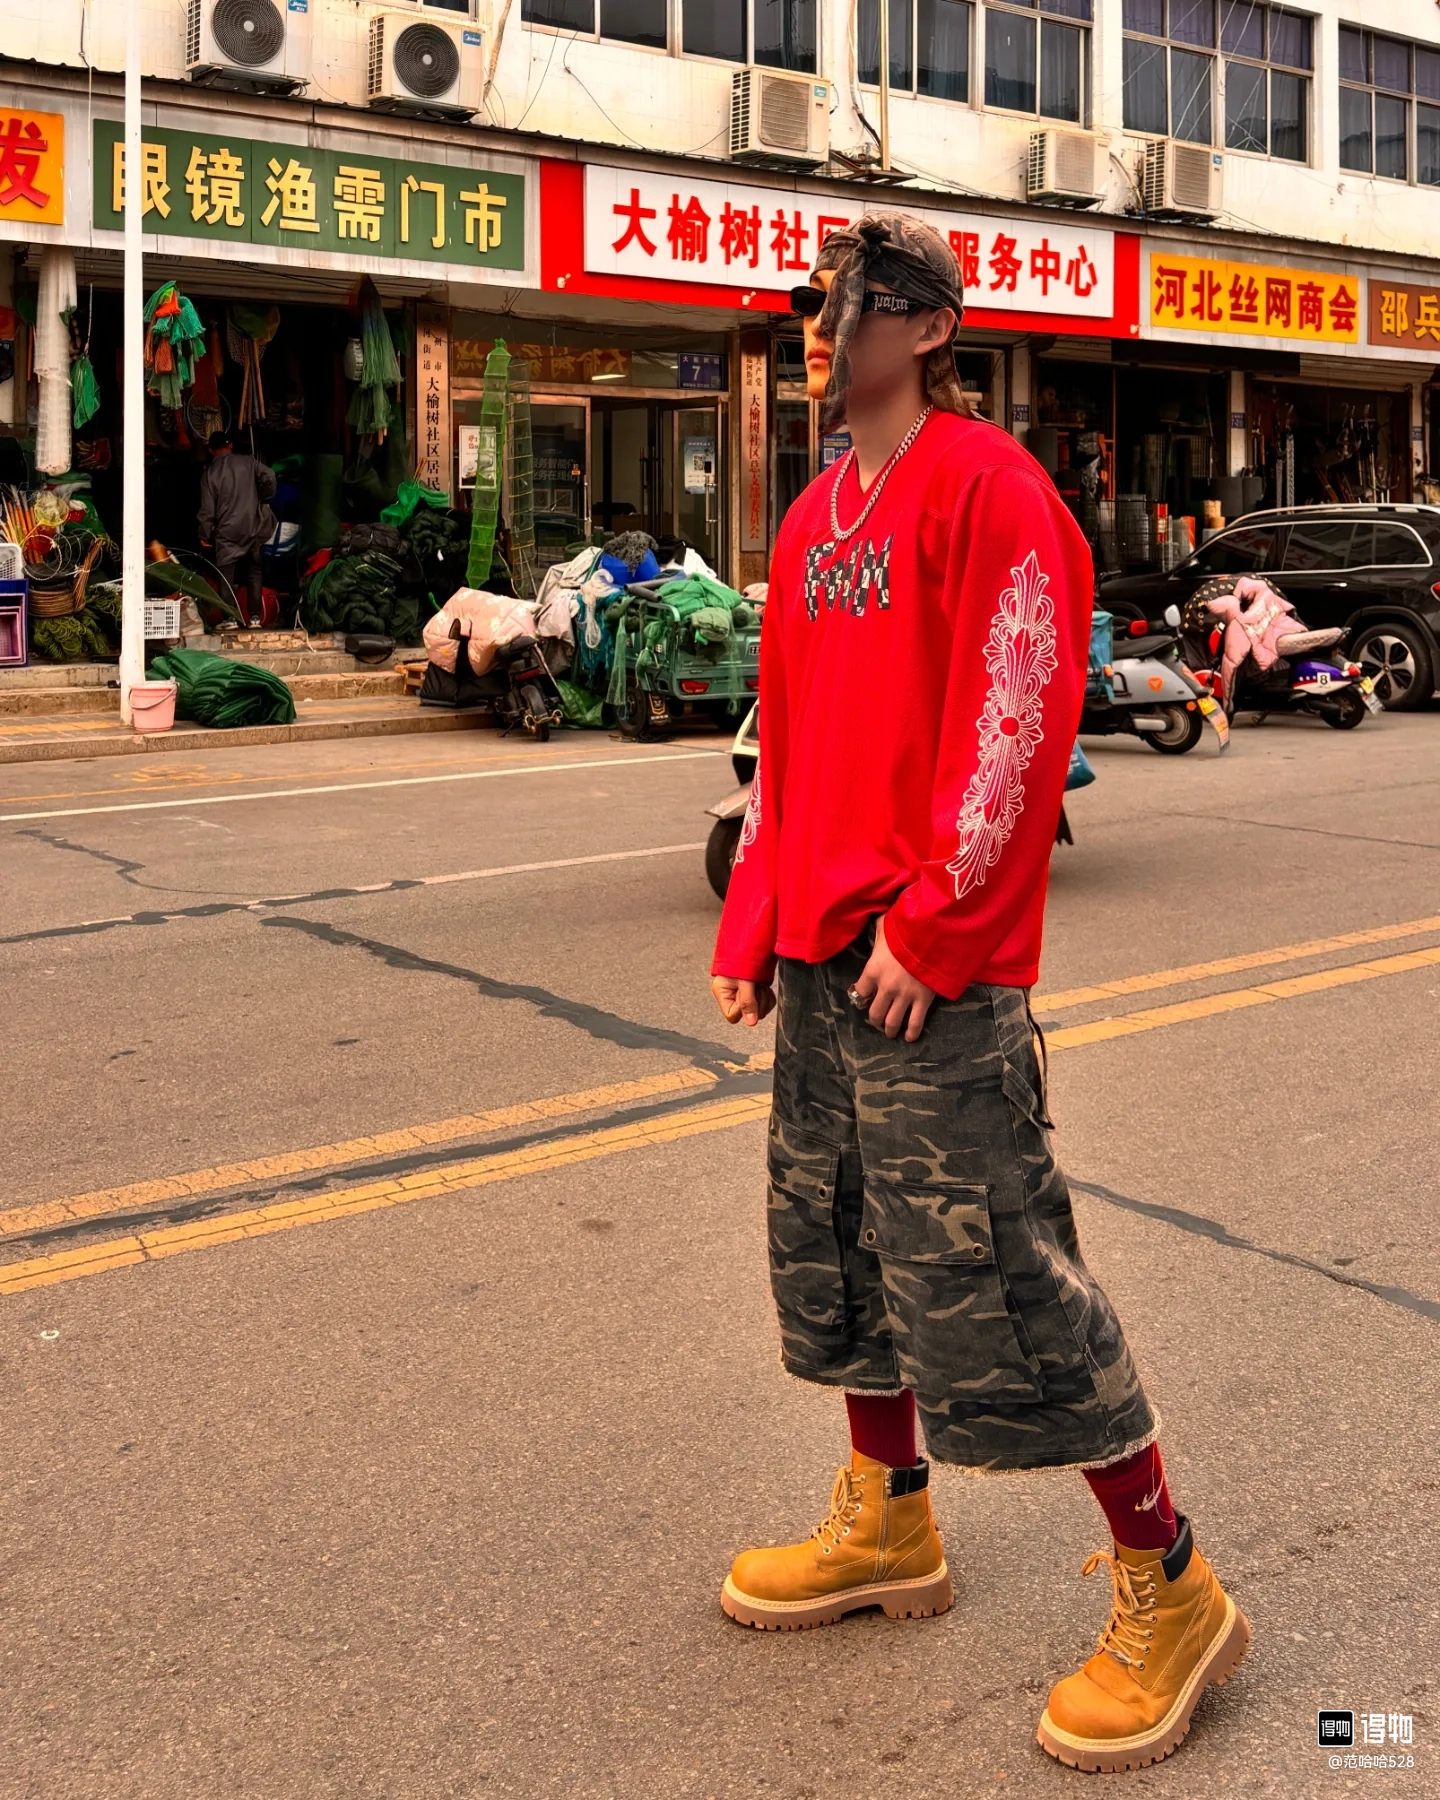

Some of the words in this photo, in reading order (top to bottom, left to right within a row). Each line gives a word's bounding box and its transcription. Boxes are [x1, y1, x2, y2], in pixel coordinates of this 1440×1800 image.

[112, 141, 507, 253] 眼镜渔需门市
[1154, 264, 1357, 333] 河北丝网商会
[692, 365, 701, 381] 7
[426, 376, 440, 491] 大榆树社区居民
[1319, 674, 1329, 686] 8
